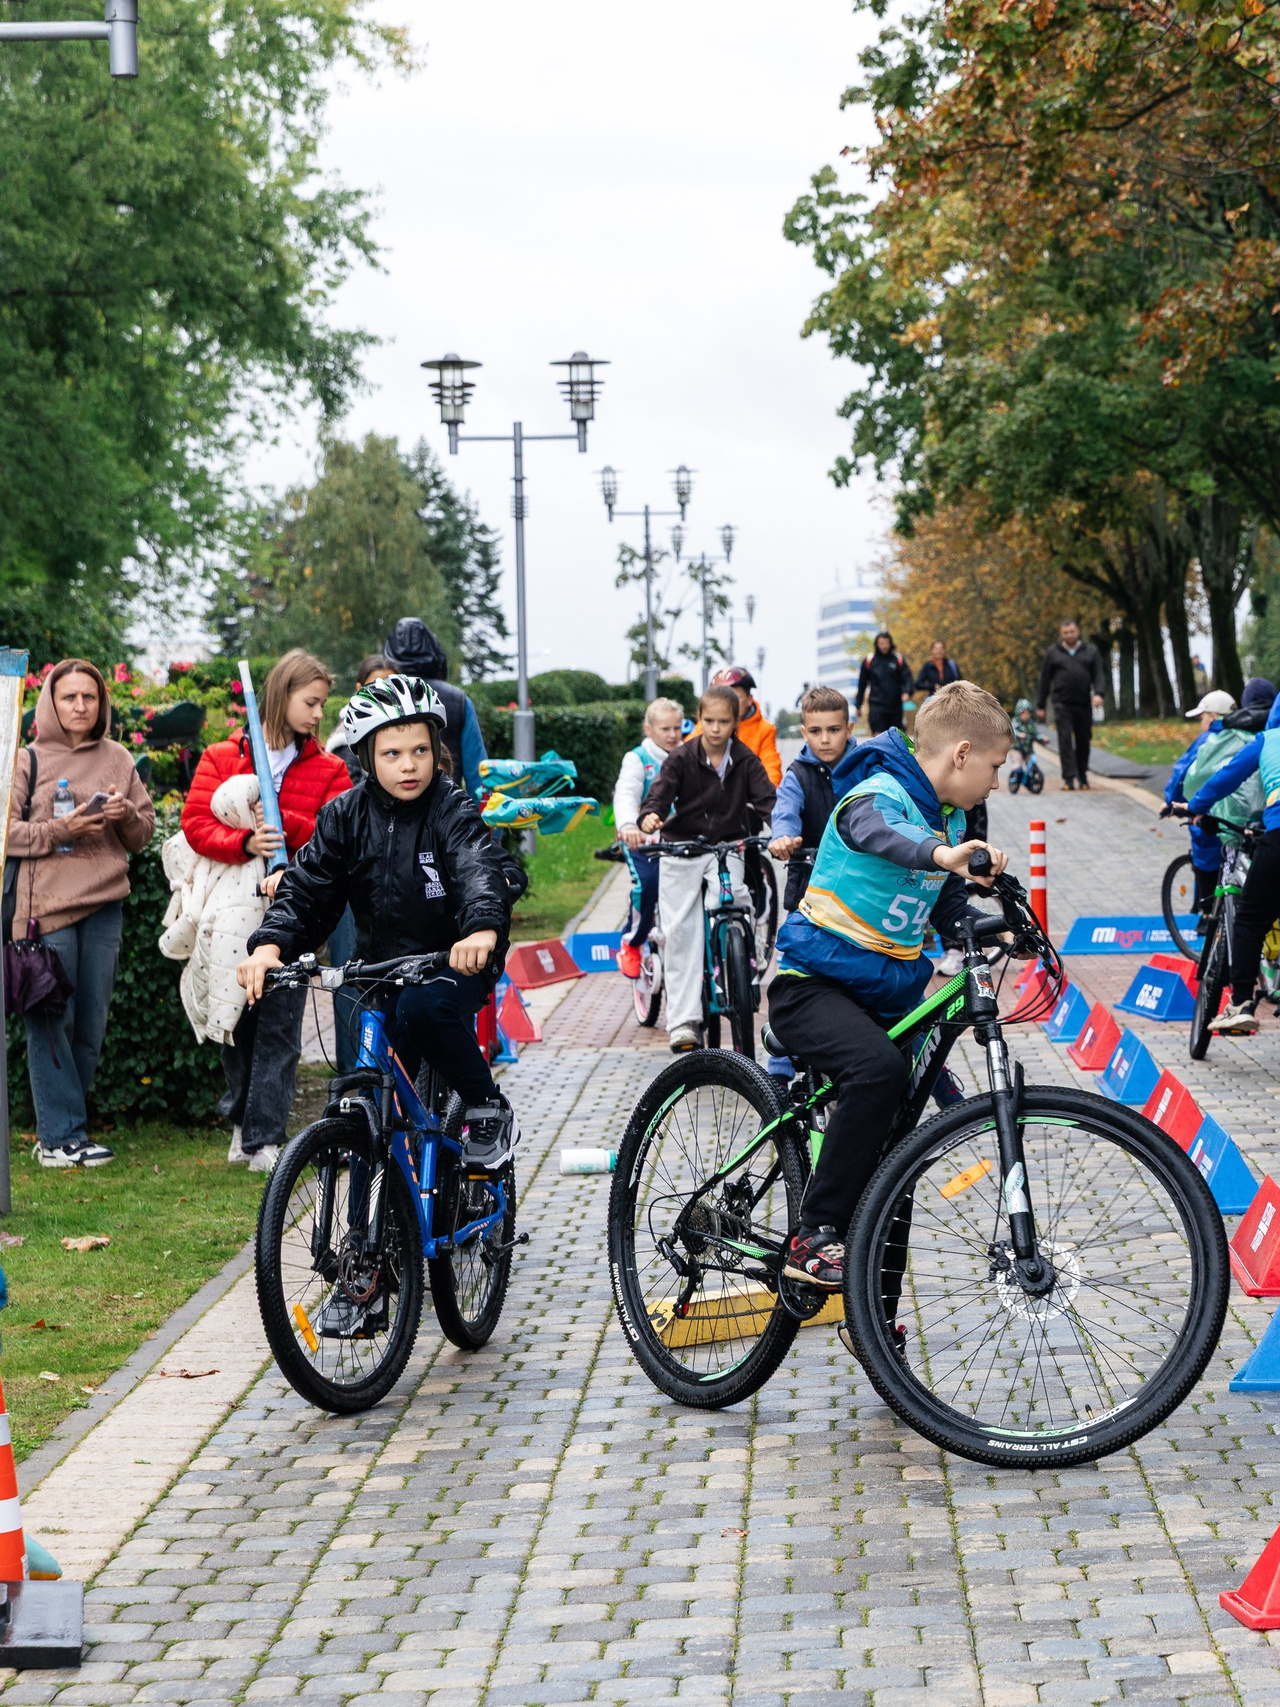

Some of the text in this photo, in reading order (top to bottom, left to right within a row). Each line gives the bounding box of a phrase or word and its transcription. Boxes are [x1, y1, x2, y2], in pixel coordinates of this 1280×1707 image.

[946, 994, 966, 1021] 29
[611, 1261, 641, 1342] CST ALL TERRAINS
[987, 1435, 1089, 1452] CST ALL TERRAINS
